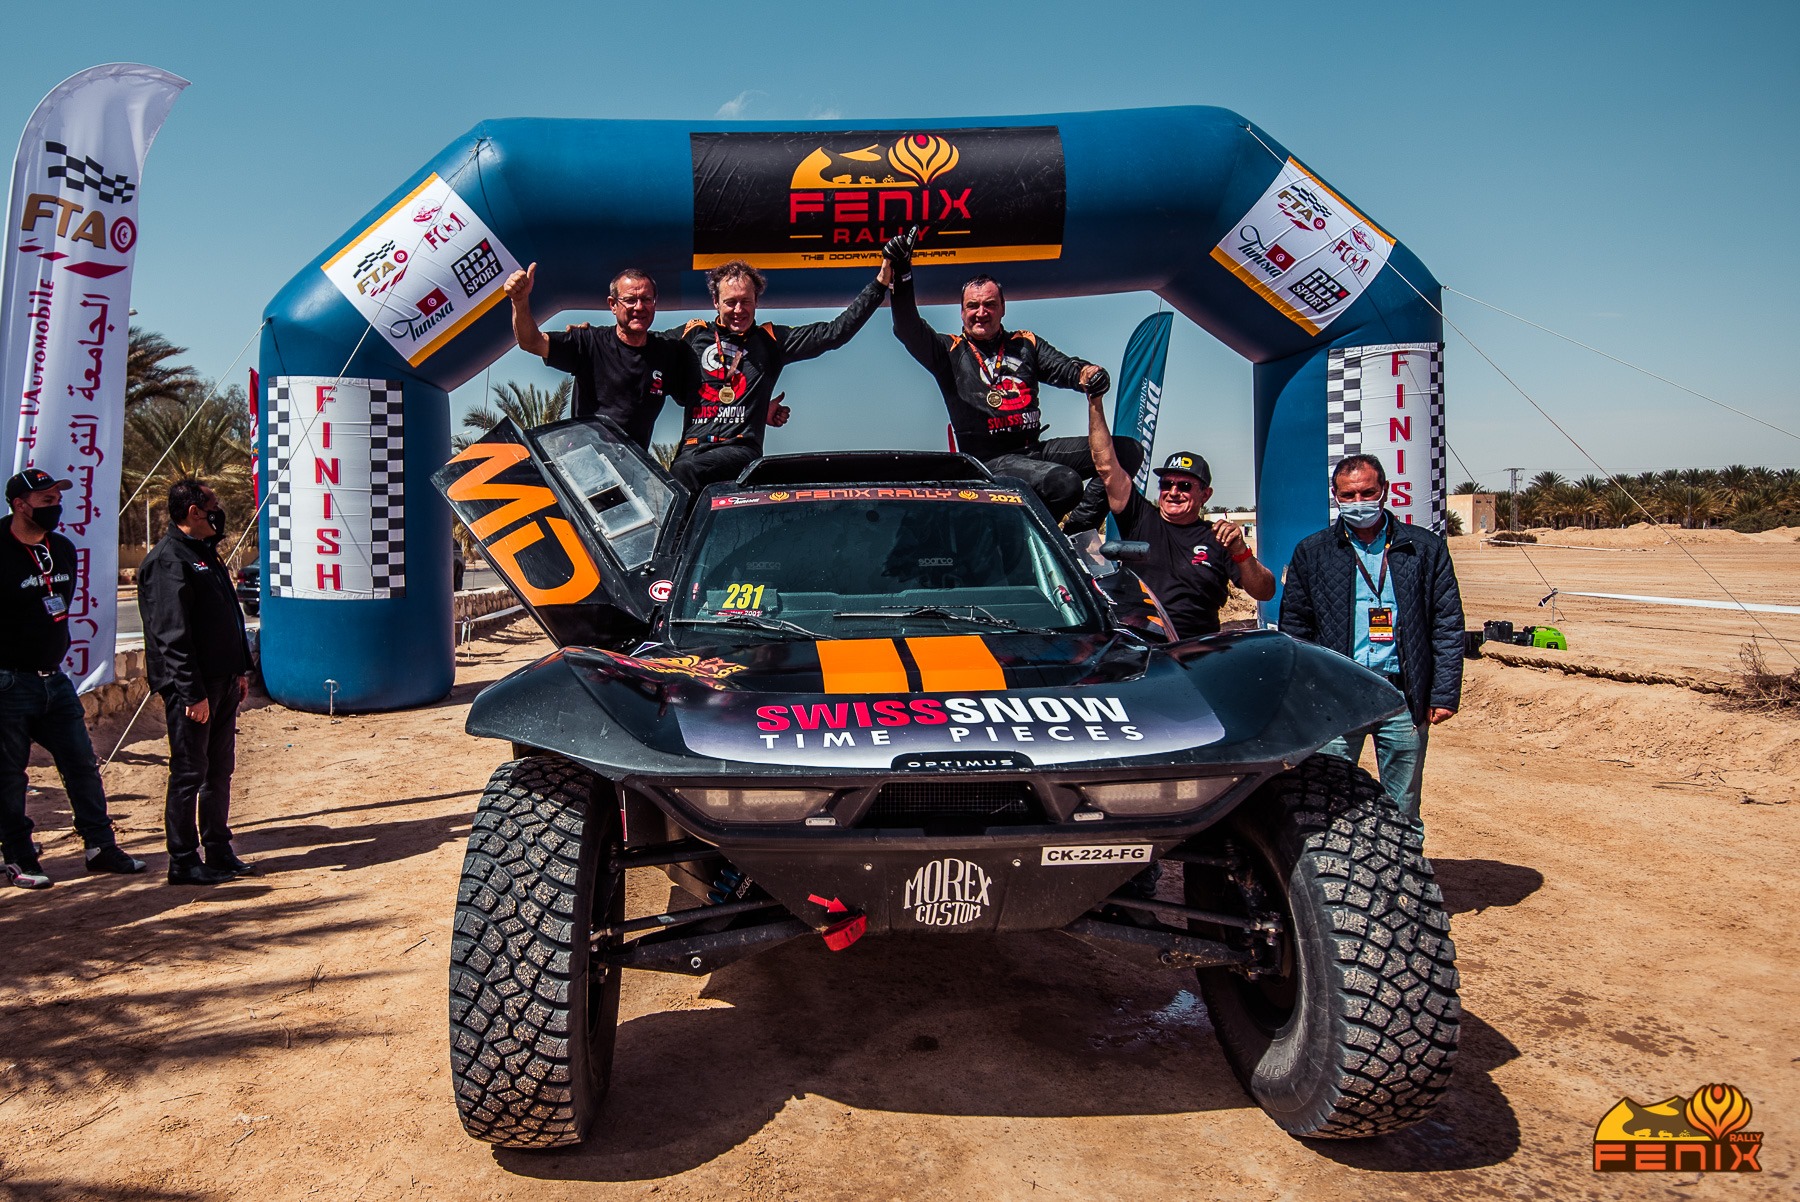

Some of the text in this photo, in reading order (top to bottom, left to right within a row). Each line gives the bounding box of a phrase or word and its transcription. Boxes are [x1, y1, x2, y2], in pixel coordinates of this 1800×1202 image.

[21, 193, 107, 249] FTA
[789, 188, 973, 224] FENIX
[1277, 190, 1313, 222] FTA
[911, 250, 957, 259] SAHARA
[1238, 224, 1285, 278] Tunisia
[356, 261, 397, 295] FTA
[466, 261, 500, 295] SPORT
[1292, 285, 1329, 311] SPORT
[389, 301, 455, 342] Tunisia
[67, 293, 116, 401] الجامعة
[1136, 376, 1149, 433] INSPIRING
[59, 414, 105, 536] التونسية
[1168, 456, 1193, 468] MD
[315, 385, 343, 591] FINISH
[795, 488, 871, 499] FENIX
[878, 488, 952, 499] RALLY
[988, 493, 1023, 504] 2021
[445, 443, 600, 607] MD
[918, 557, 954, 566] sparco
[722, 583, 765, 610] 231
[759, 725, 1145, 749] TIME PIECES
[907, 759, 1014, 769] OPTIMUS
[1046, 848, 1145, 862] CK-224-FG
[903, 858, 993, 910] MOREX
[915, 900, 981, 927] CUSTOM
